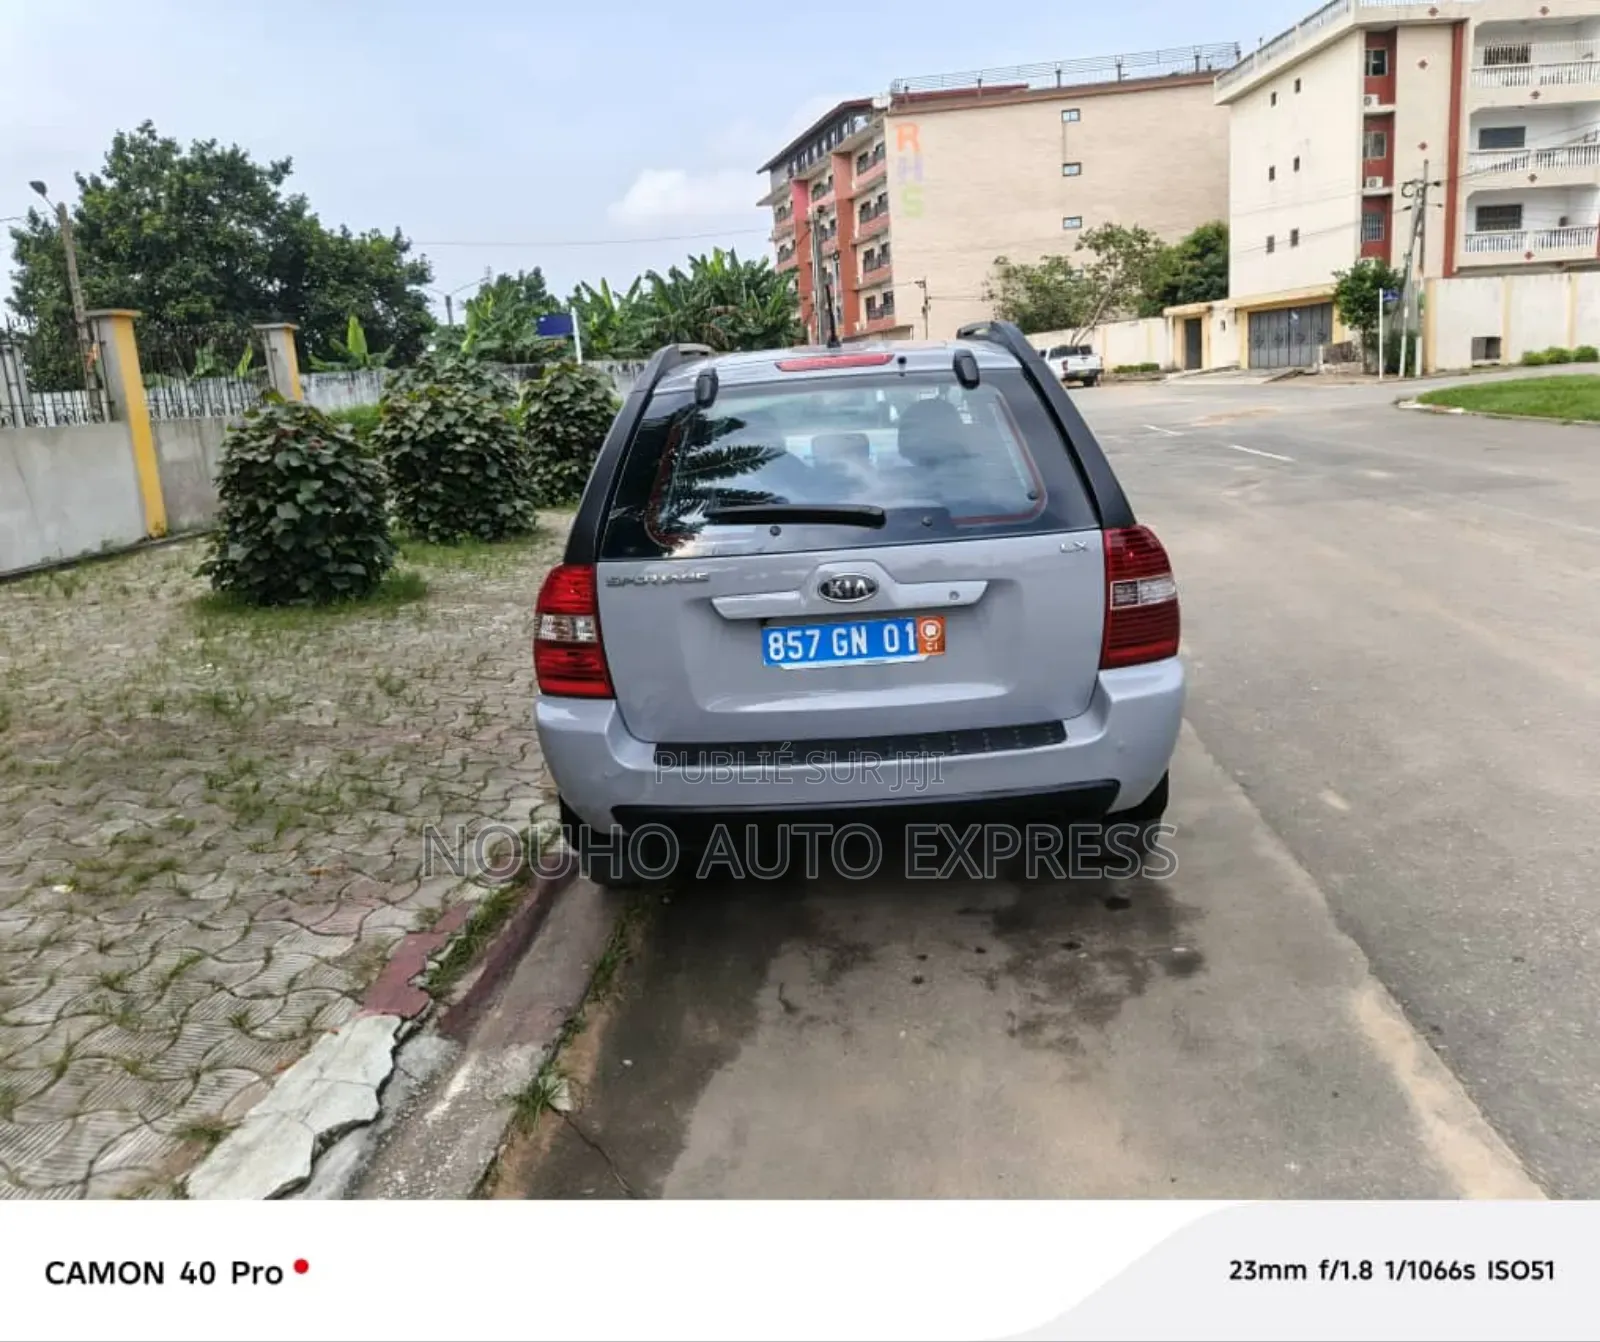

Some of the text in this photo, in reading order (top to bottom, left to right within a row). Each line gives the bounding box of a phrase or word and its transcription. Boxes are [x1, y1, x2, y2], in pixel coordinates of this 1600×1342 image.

[828, 578, 869, 598] KIA
[768, 621, 916, 661] 857 GN 01
